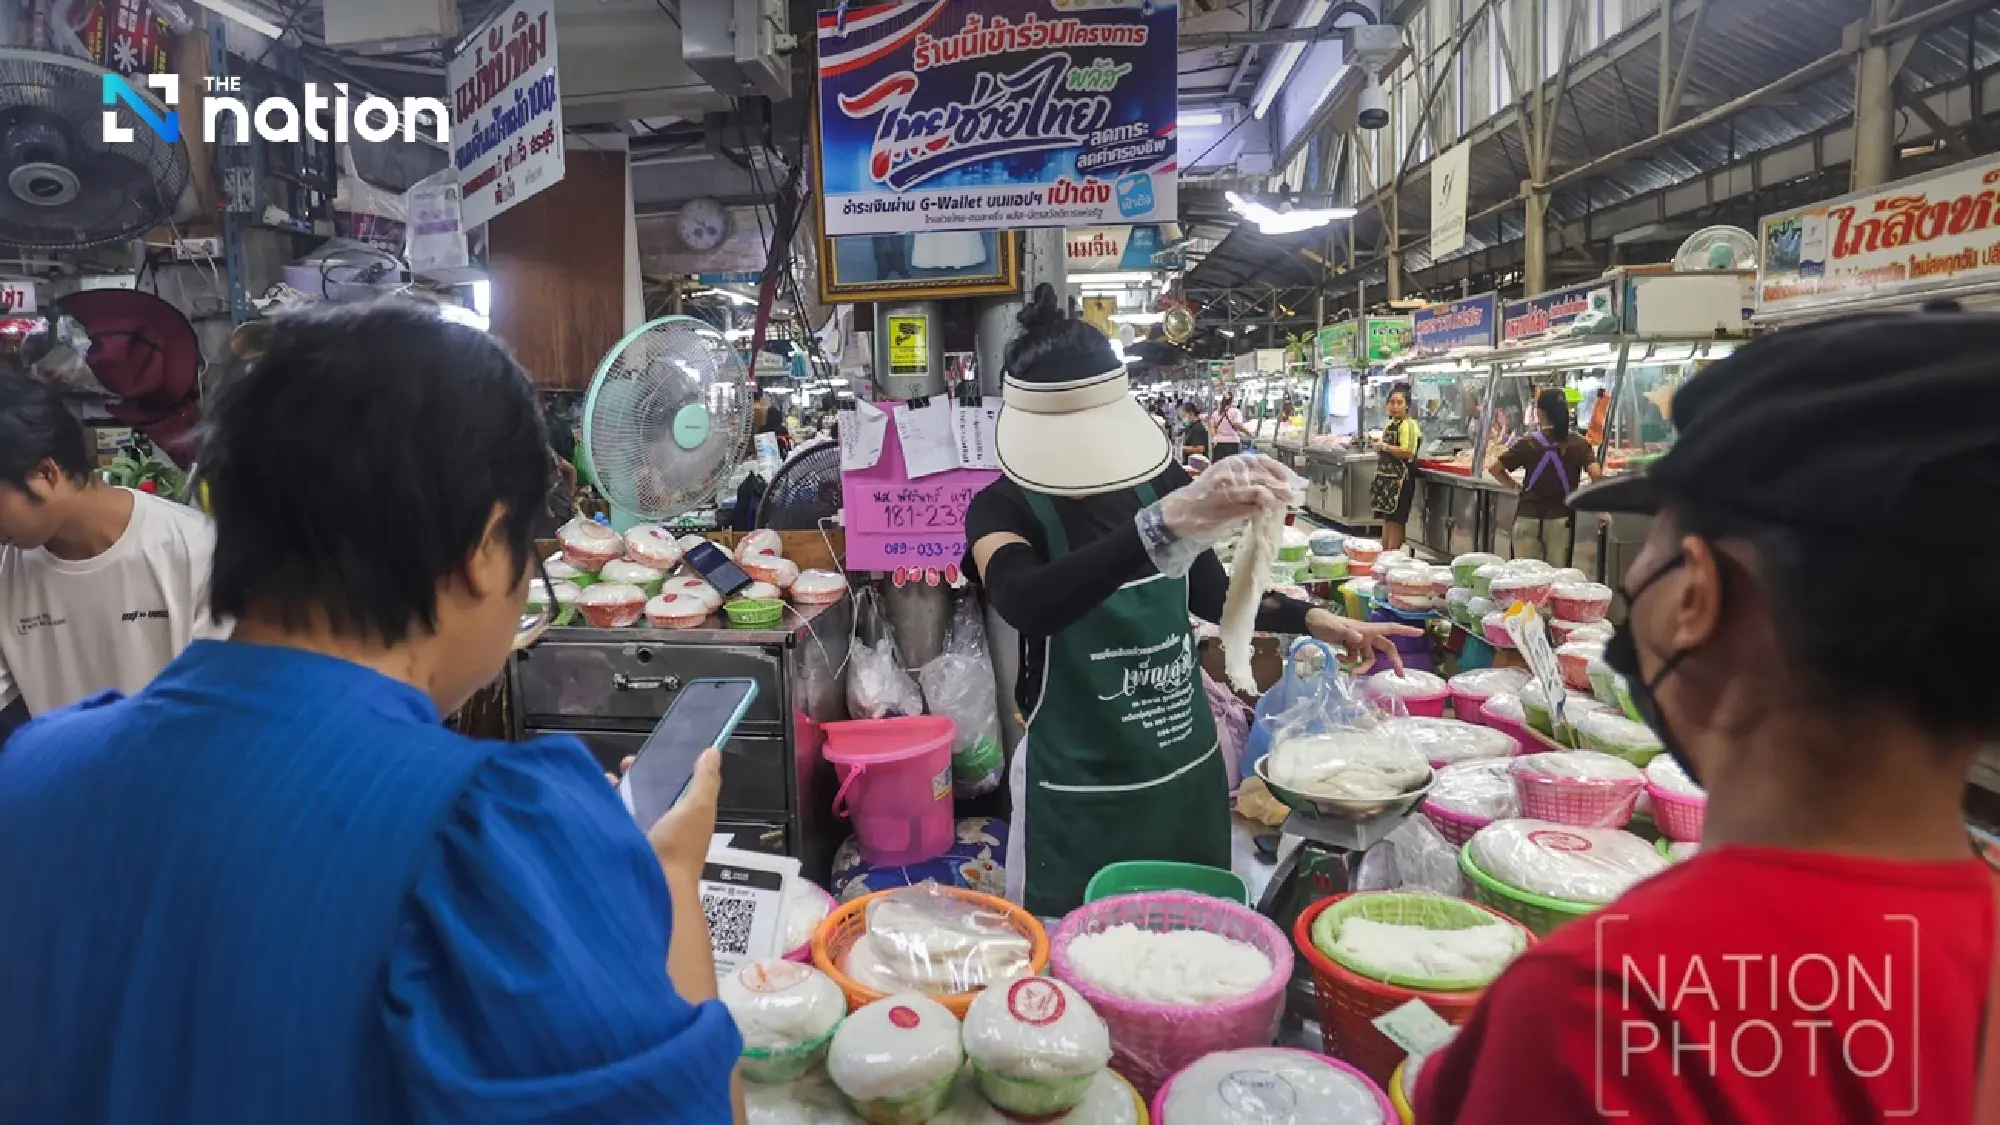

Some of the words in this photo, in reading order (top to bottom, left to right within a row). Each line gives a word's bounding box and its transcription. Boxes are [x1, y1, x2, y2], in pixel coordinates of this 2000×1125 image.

[1067, 58, 1132, 91] พลัส
[1090, 122, 1149, 146] ลดภาระ
[1077, 139, 1167, 168] ลดค่าครองชีพ
[842, 194, 916, 215] ชำระเงินผ่าน
[919, 194, 982, 212] G-Wallet
[986, 191, 1043, 208] บนแอปฯ
[1047, 177, 1111, 206] เป๋าตัง
[1067, 232, 1118, 258] นมจีน
